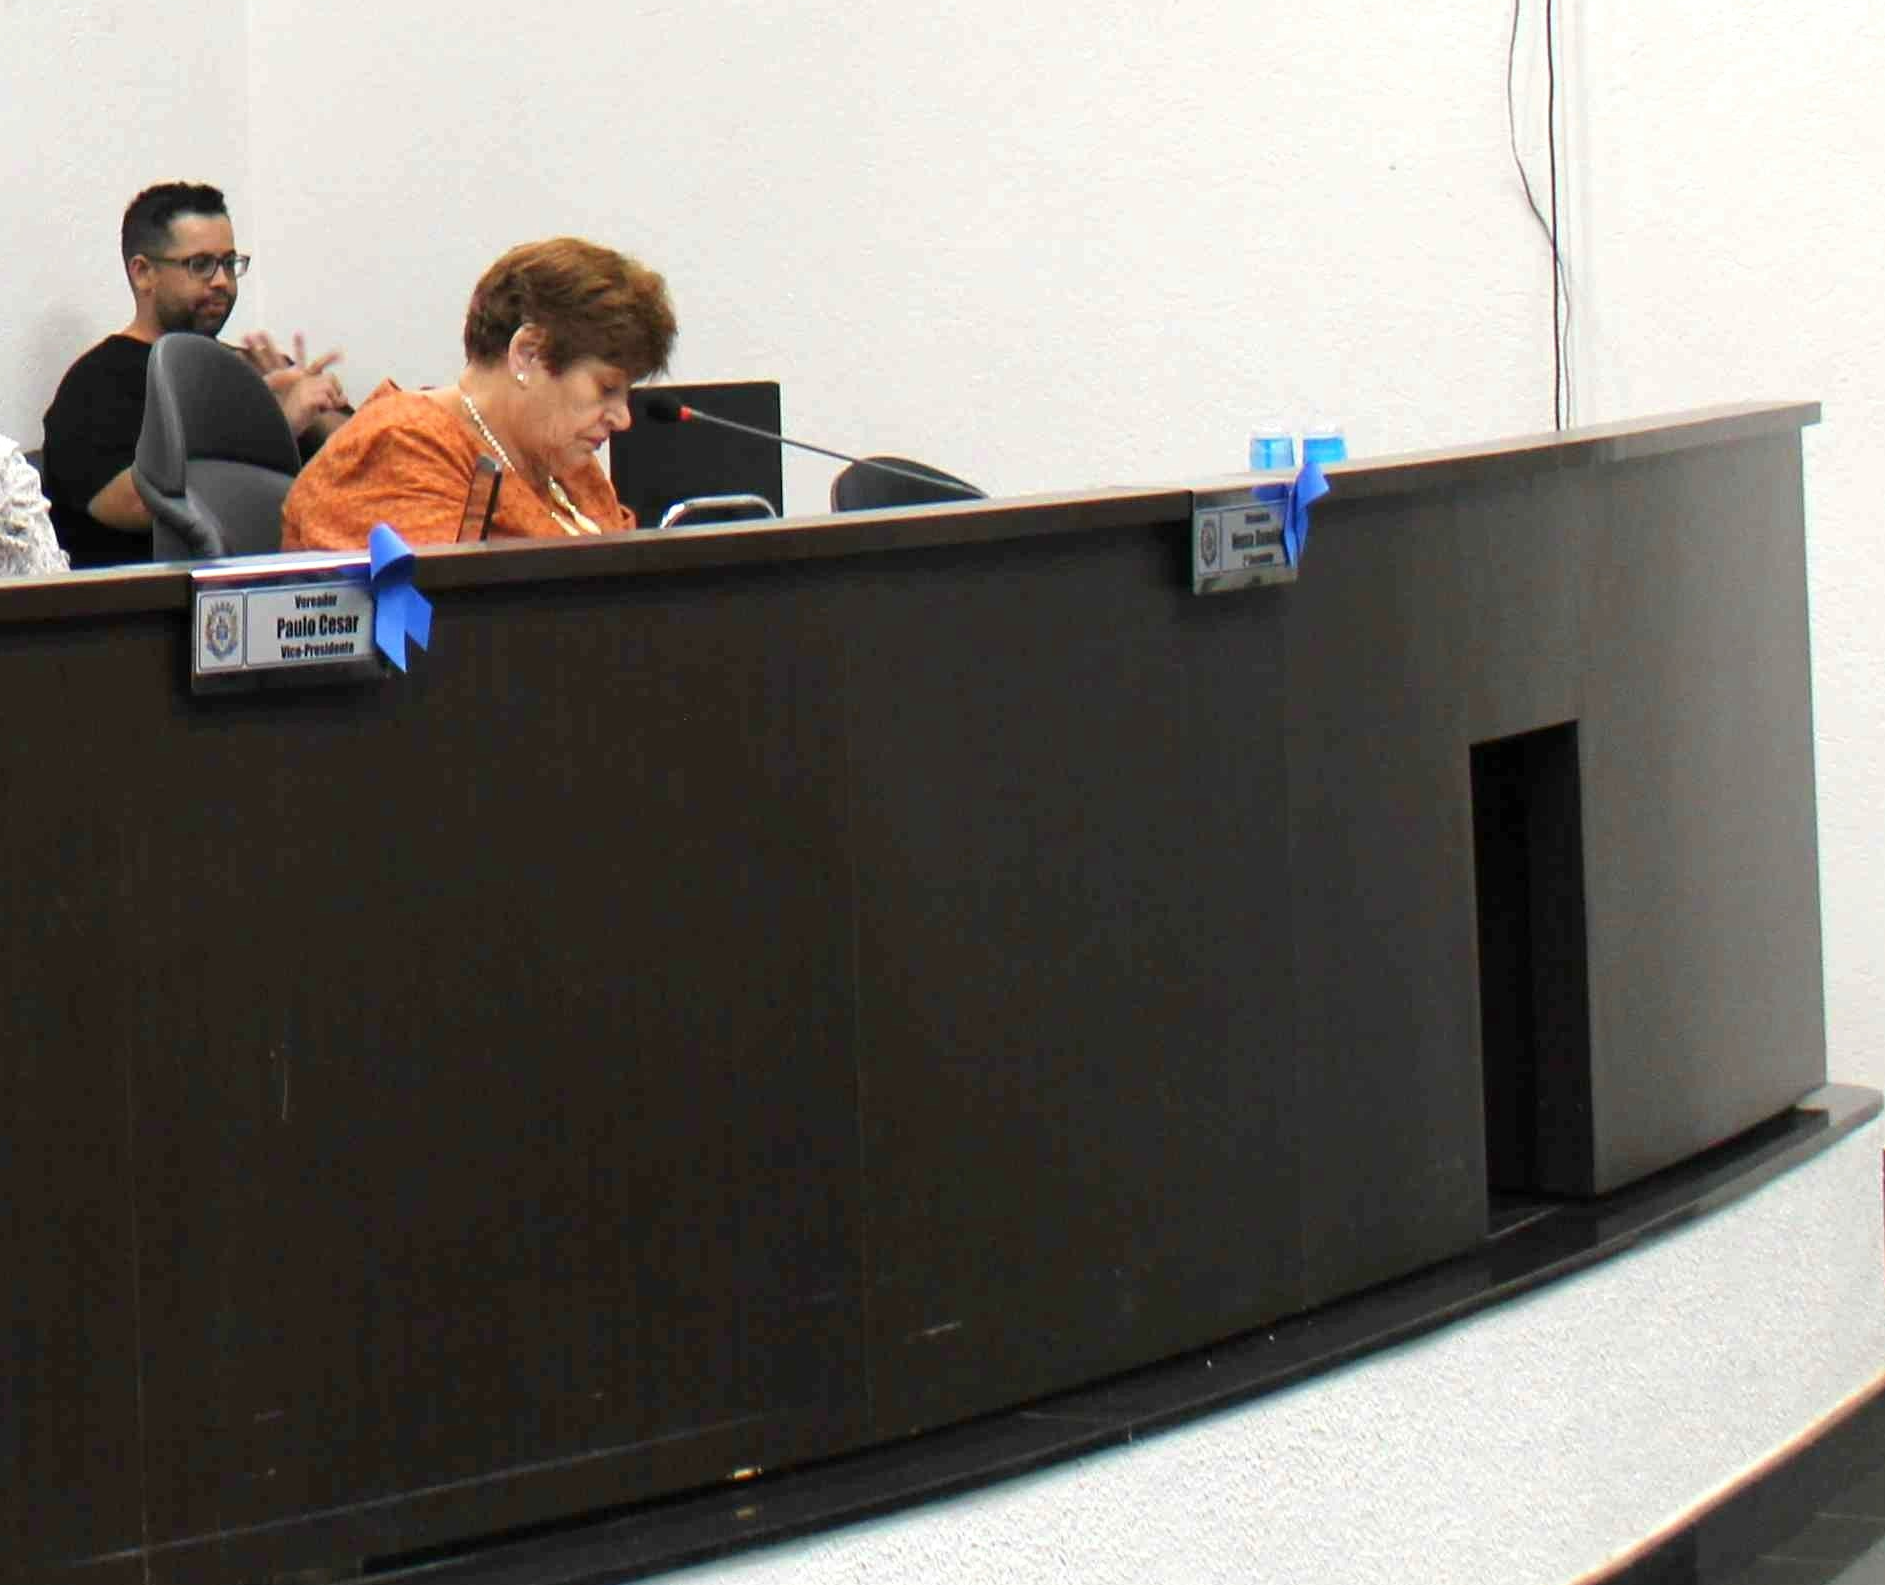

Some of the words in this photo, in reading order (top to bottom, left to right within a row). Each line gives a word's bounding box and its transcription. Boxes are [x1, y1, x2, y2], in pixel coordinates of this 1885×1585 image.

[277, 616, 316, 639] Paulo
[319, 614, 358, 636] Cesar
[281, 641, 355, 659] Vice-Presidente
